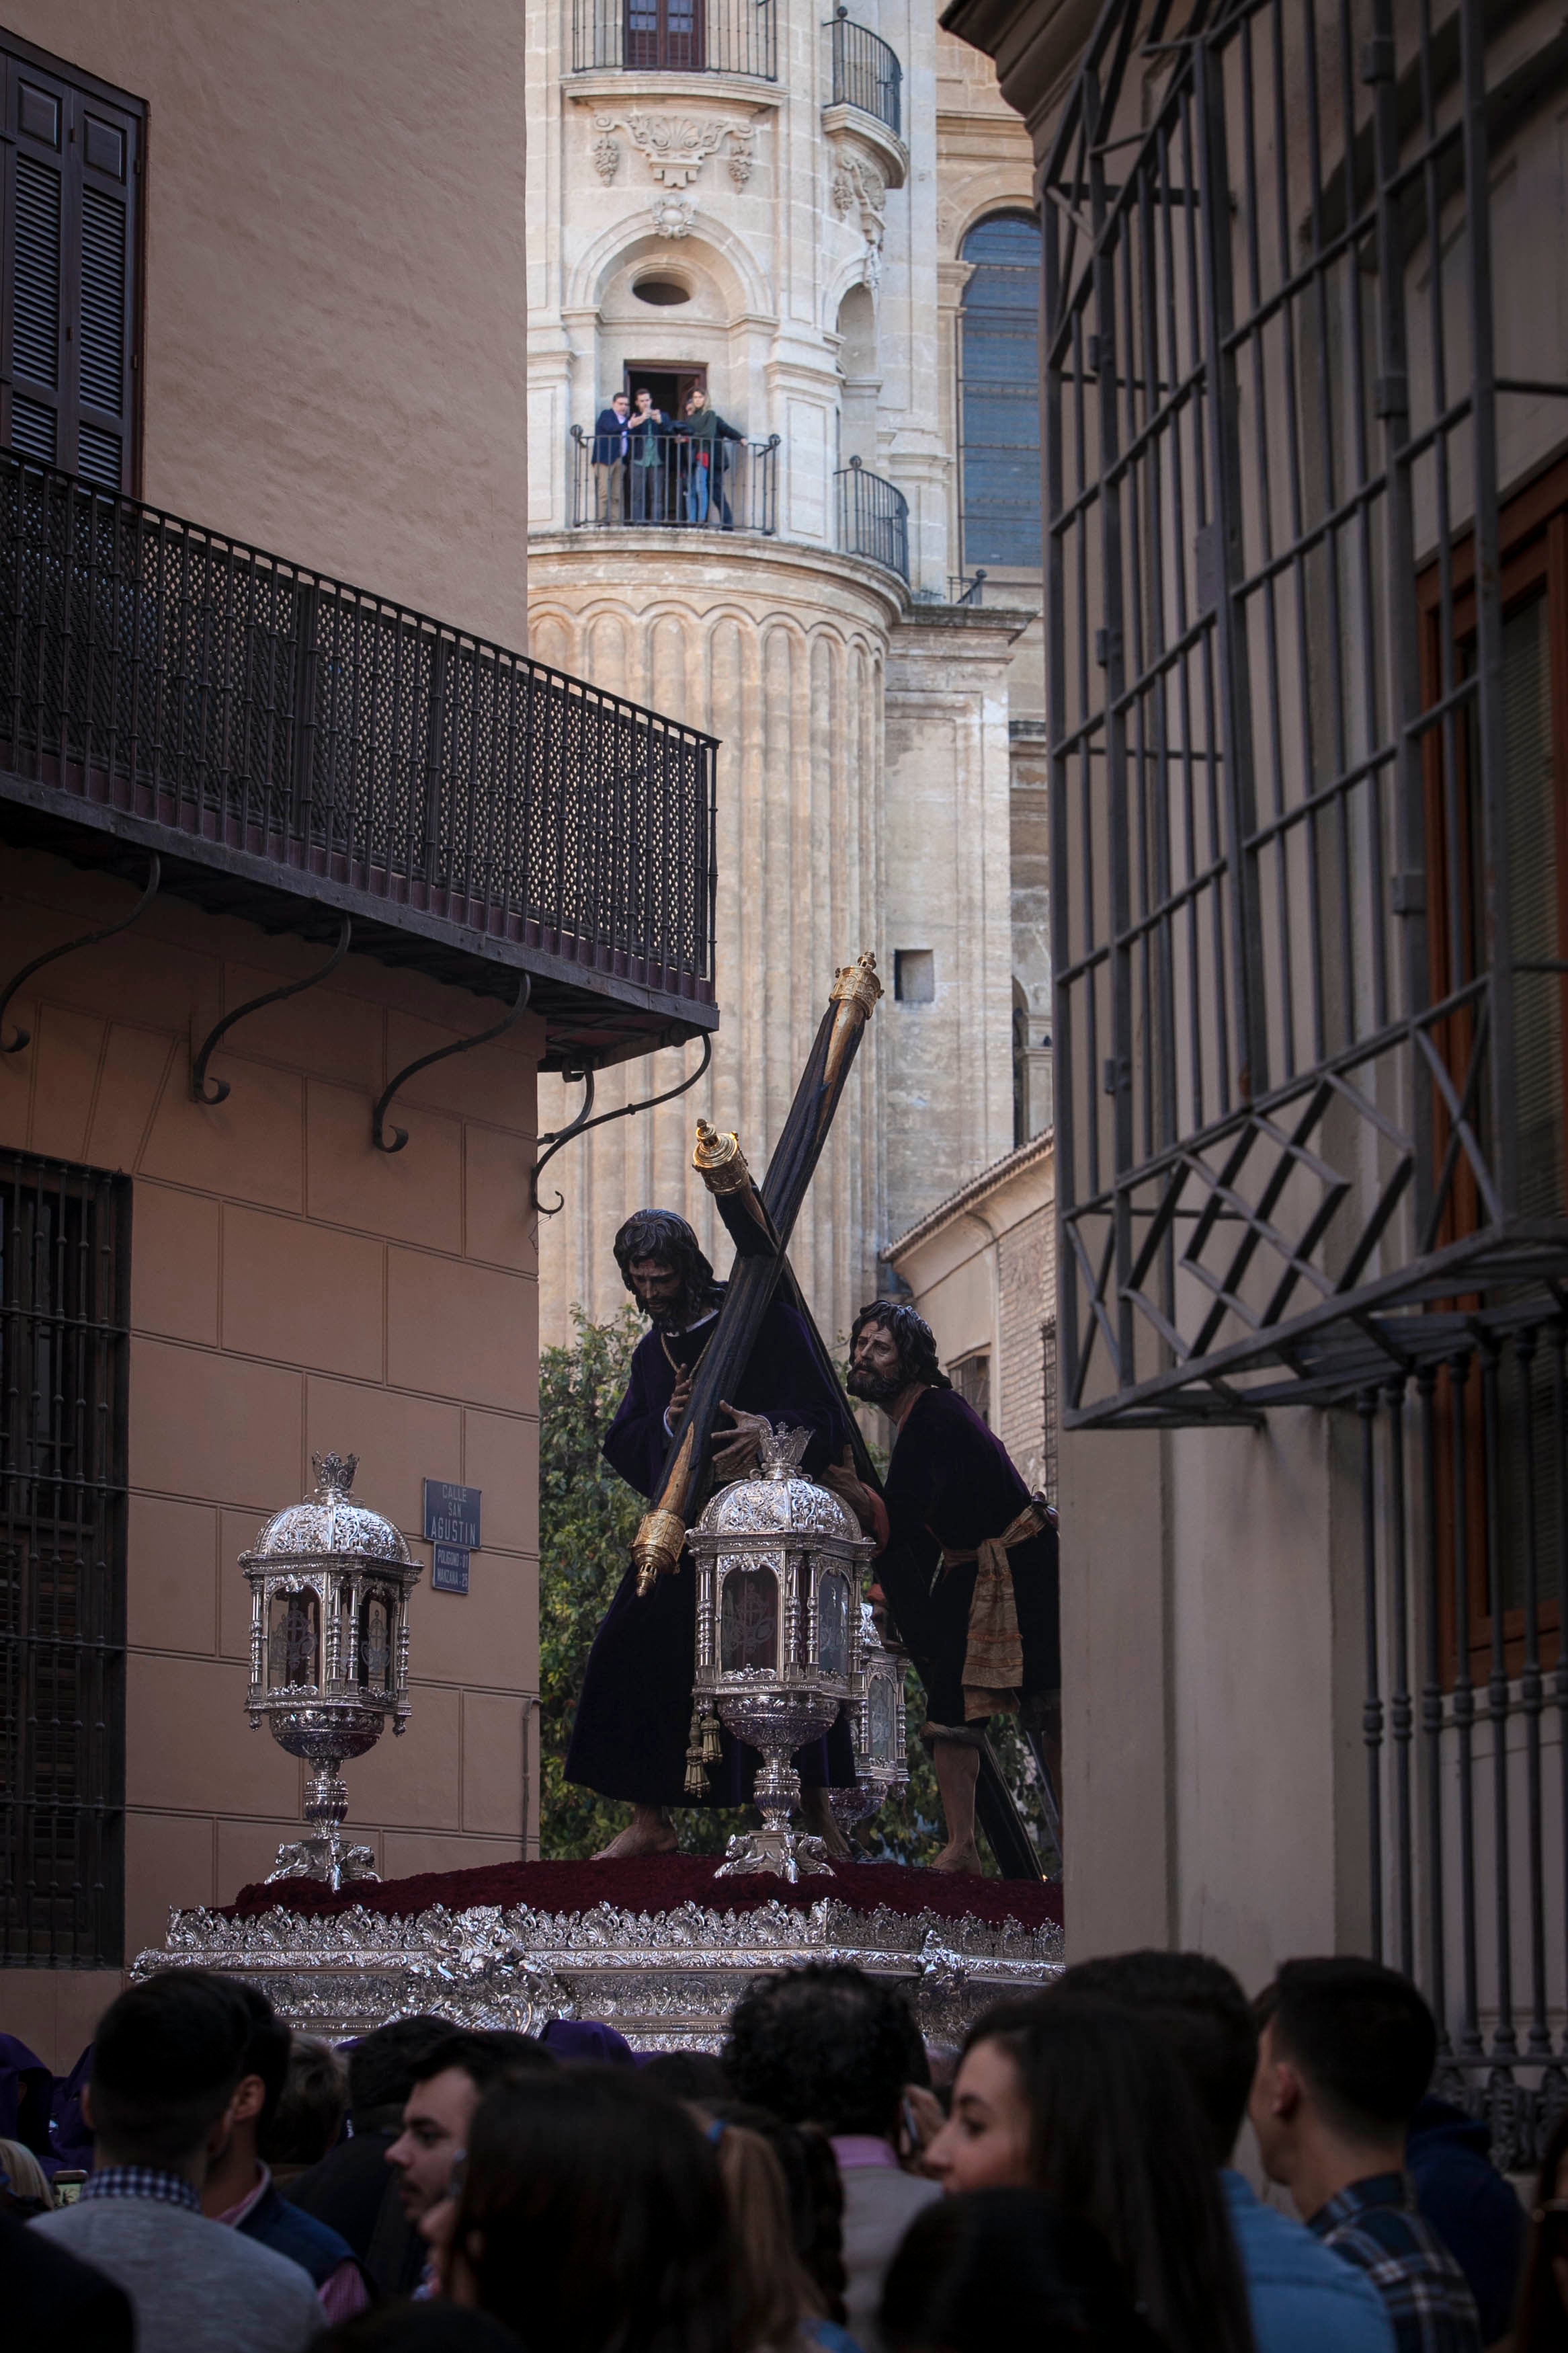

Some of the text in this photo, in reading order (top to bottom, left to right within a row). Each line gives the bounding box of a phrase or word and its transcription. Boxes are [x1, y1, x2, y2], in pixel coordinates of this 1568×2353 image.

[442, 1484, 467, 1502] CALLE
[448, 1502, 462, 1518] SAN
[431, 1516, 476, 1545] AGUSTIN
